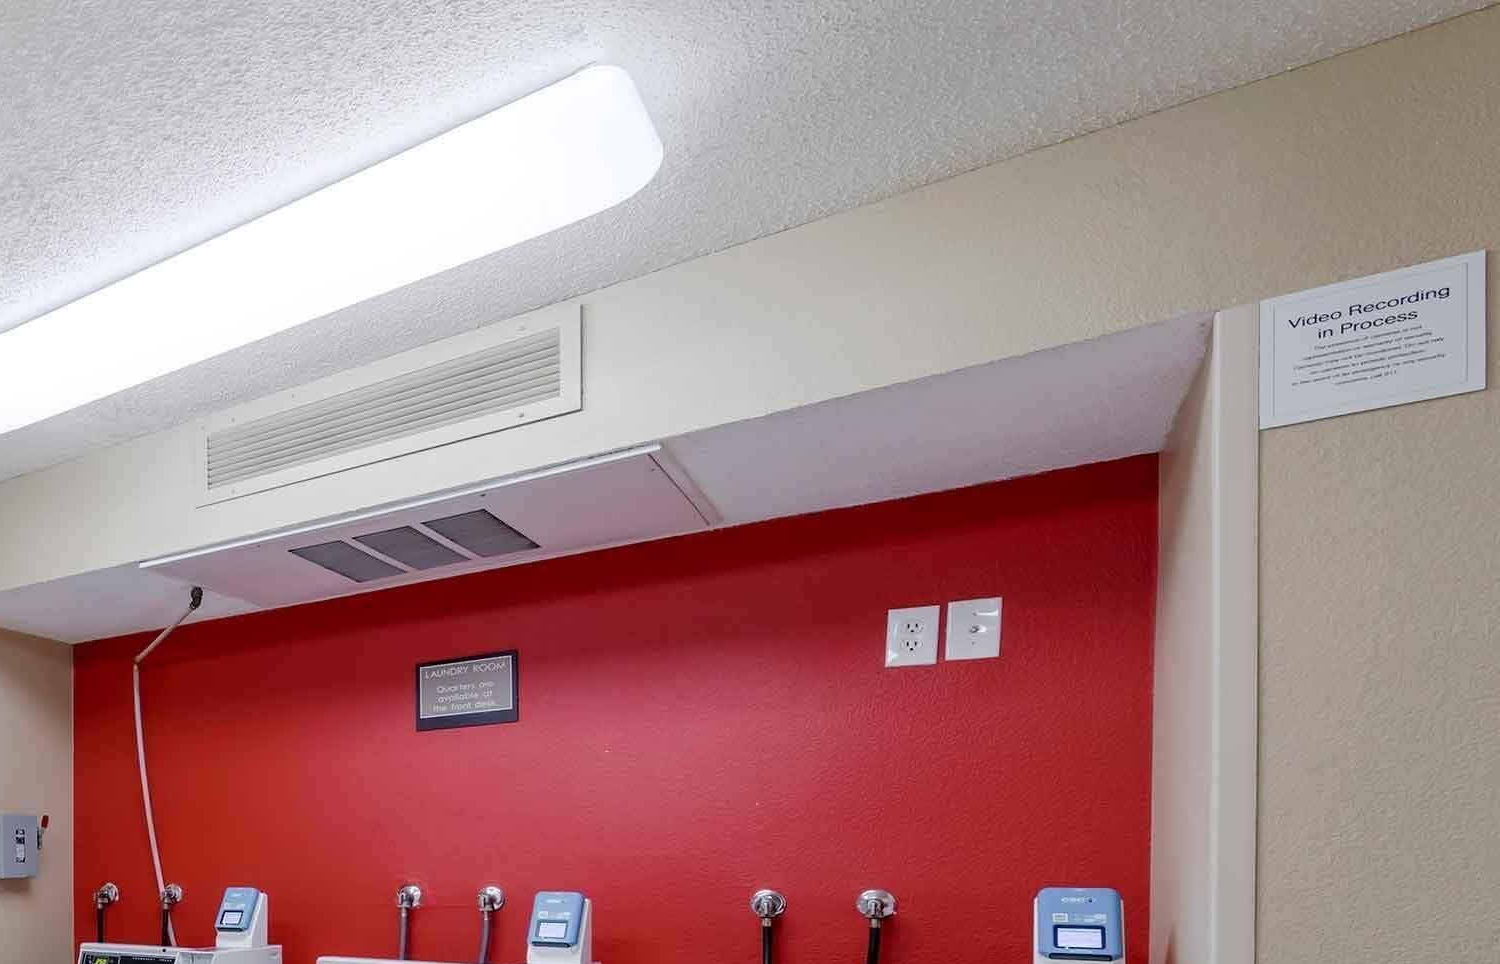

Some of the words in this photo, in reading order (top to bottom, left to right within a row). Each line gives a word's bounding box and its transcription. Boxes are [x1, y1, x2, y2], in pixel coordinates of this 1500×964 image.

[1288, 311, 1342, 329] Video
[1348, 287, 1451, 316] Recording
[1317, 326, 1334, 340] in
[1340, 310, 1419, 335] Process
[424, 665, 469, 680] LAUNDRY
[472, 661, 506, 674] ROOM
